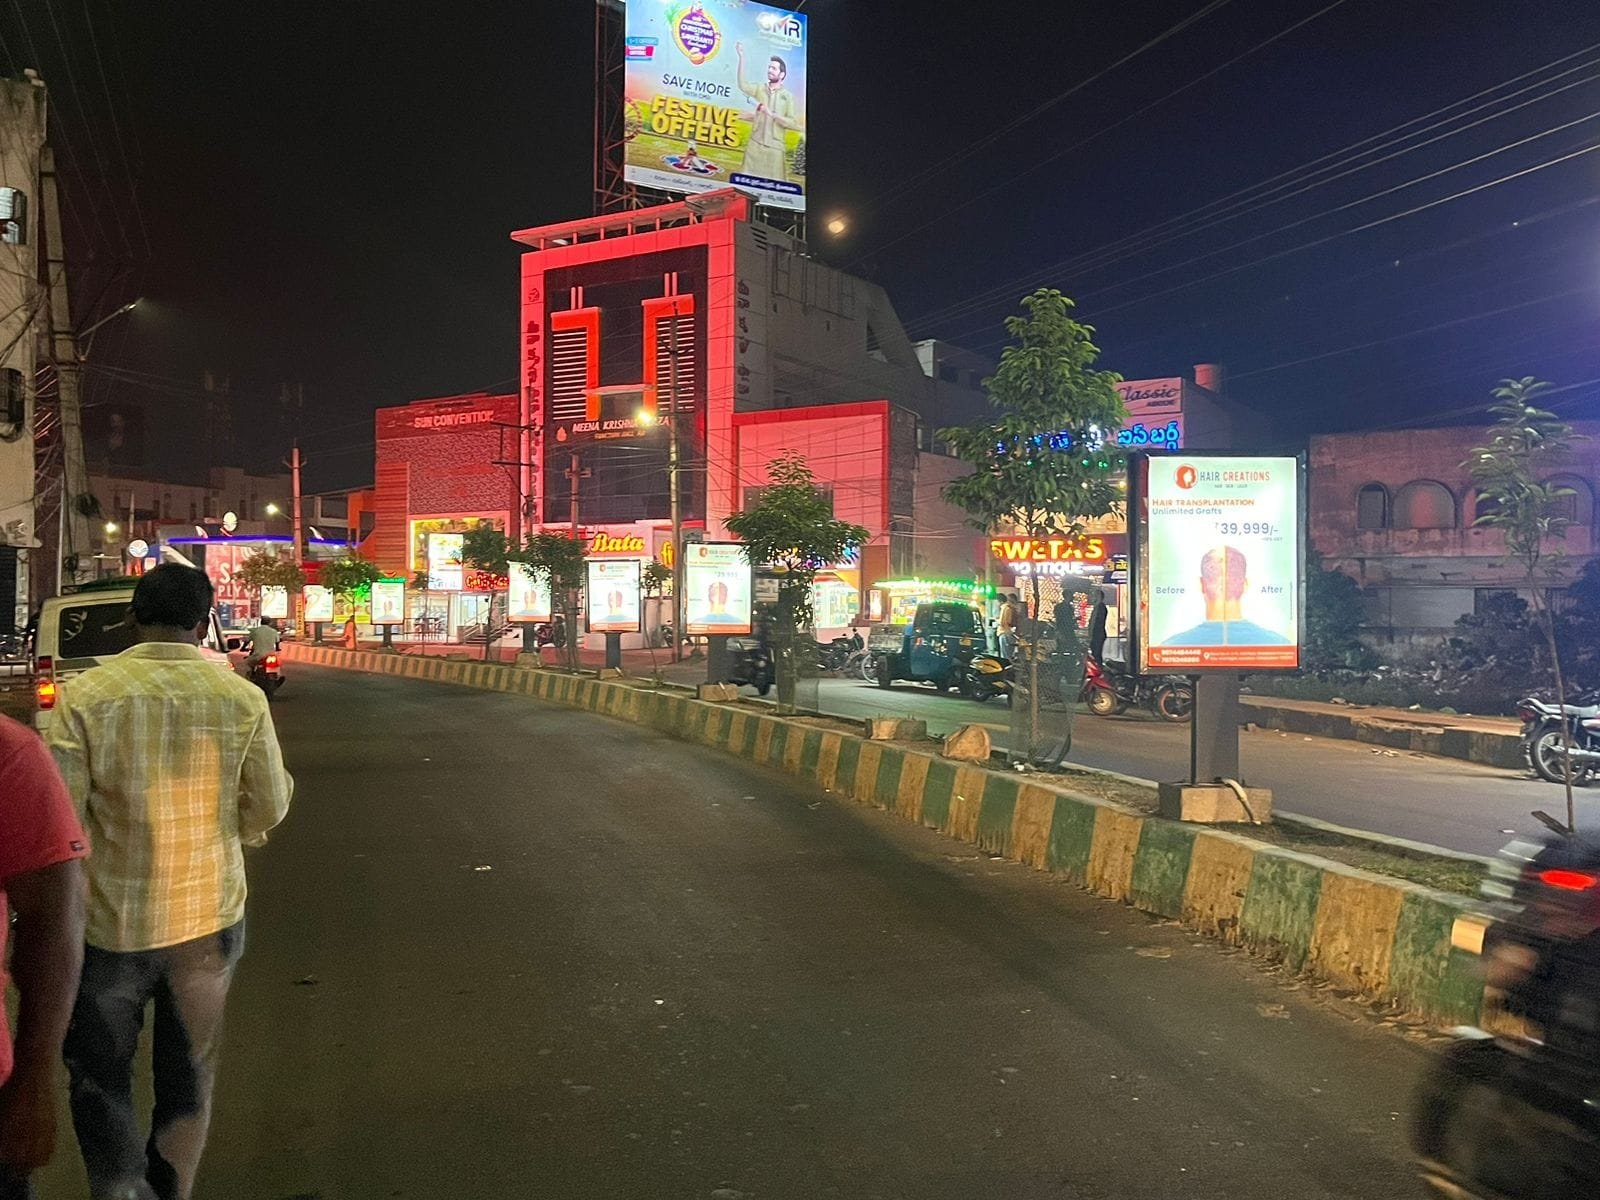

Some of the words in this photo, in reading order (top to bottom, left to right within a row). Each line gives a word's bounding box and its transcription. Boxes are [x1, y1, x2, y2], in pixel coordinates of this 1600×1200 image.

[662, 73, 693, 90] SAVE
[694, 80, 732, 98] MORE
[651, 93, 740, 127] FESTIVE
[651, 111, 741, 148] OFFERS
[1199, 471, 1220, 481] HAIR
[1222, 471, 1270, 481] CREATIONS
[1152, 498, 1173, 506] HAIR
[1175, 498, 1255, 507] TRANSPLANTATION
[1152, 507, 1194, 515] Unlimited
[1195, 507, 1222, 516] Grafts
[1155, 586, 1185, 595] Before
[1260, 585, 1284, 594] After
